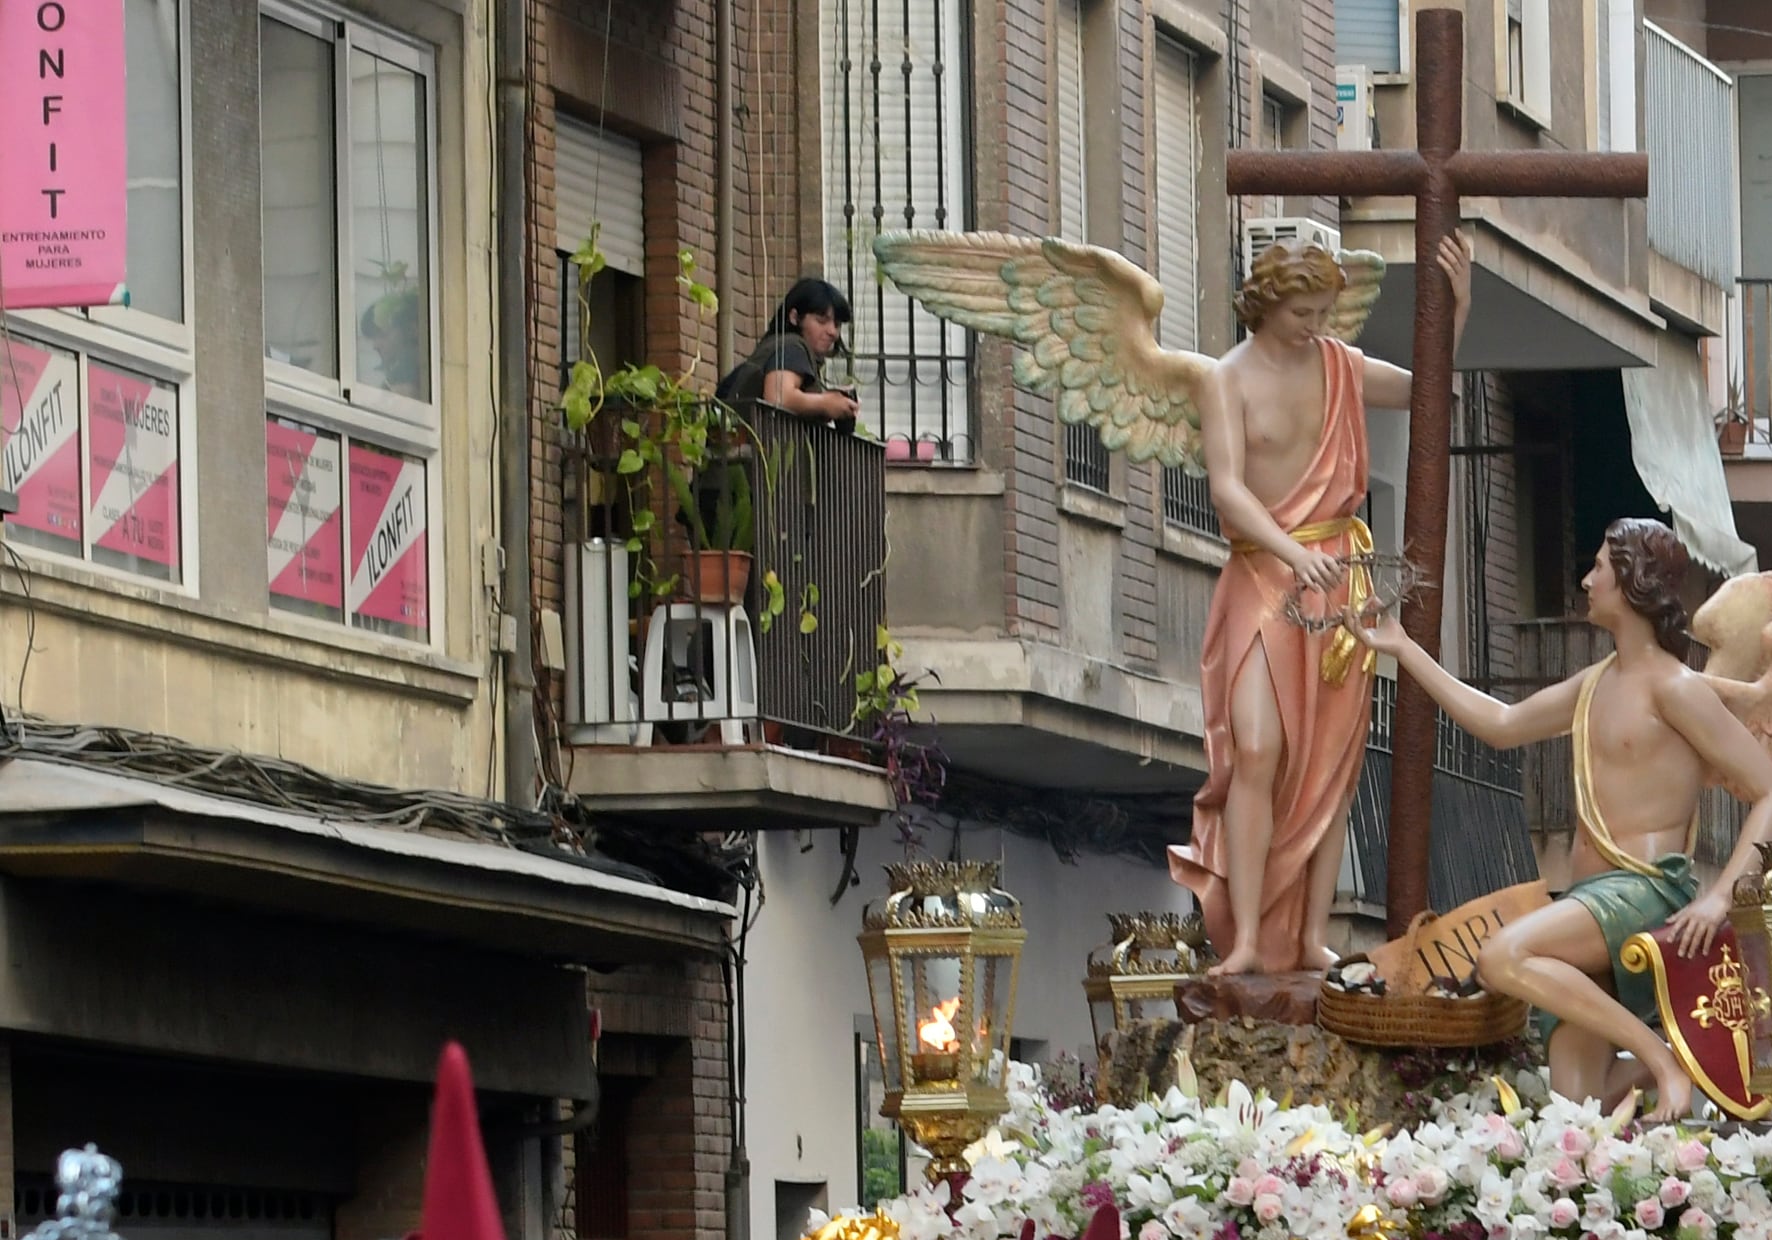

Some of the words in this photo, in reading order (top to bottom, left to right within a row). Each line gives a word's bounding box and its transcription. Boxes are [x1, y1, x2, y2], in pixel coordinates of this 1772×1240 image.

[2, 230, 106, 242] ENTRENAMIENTO
[38, 243, 70, 255] PARA
[26, 258, 82, 269] MUJERES
